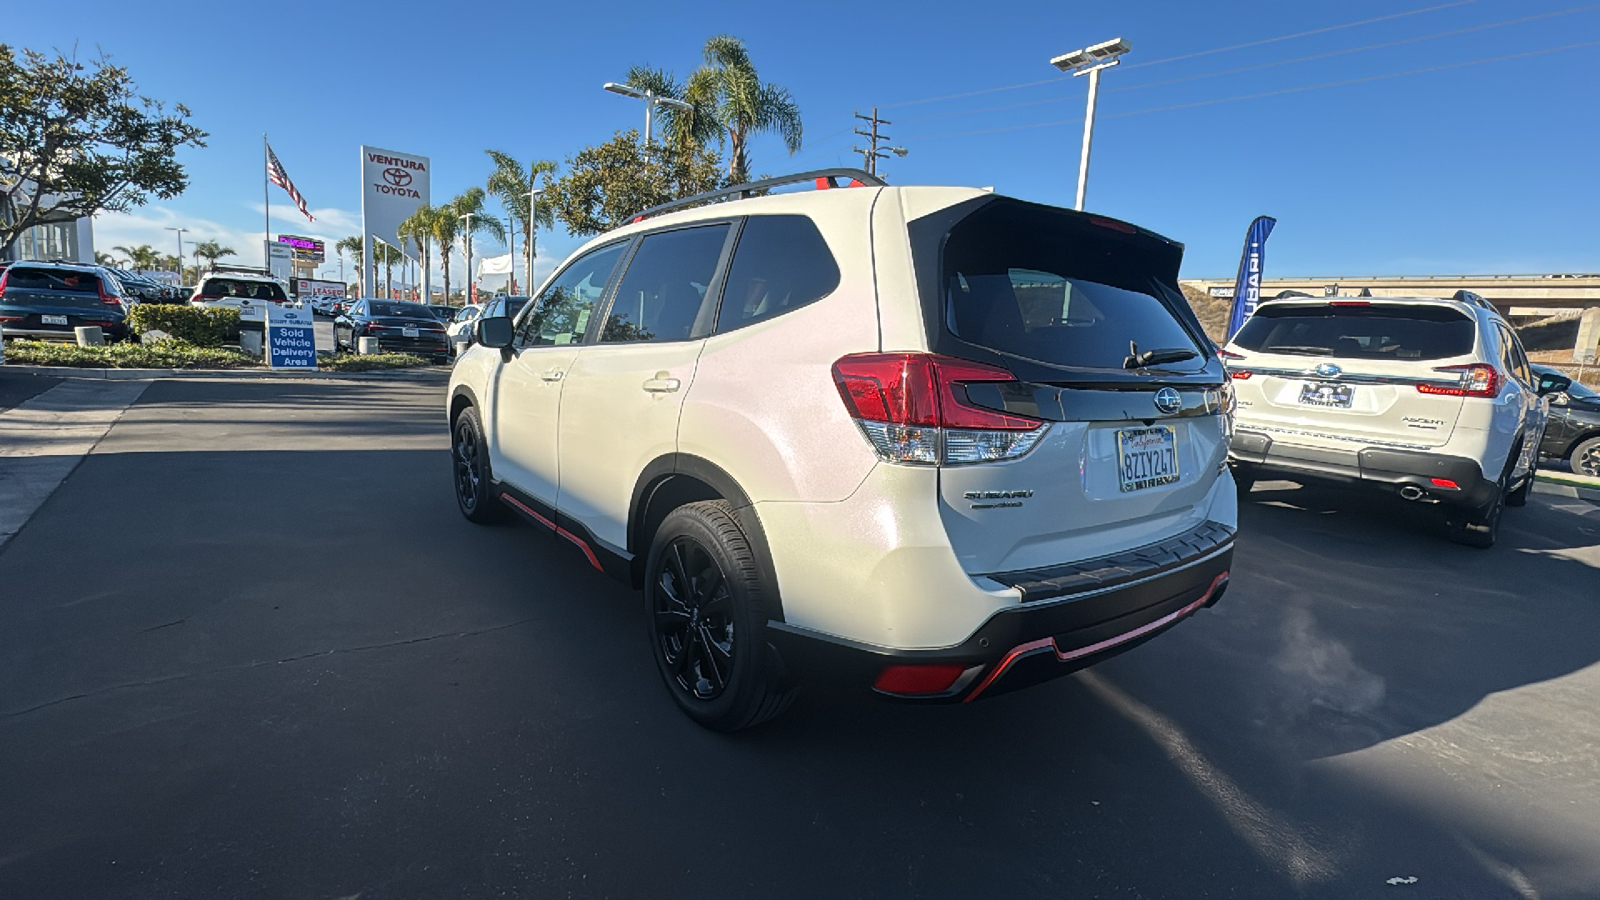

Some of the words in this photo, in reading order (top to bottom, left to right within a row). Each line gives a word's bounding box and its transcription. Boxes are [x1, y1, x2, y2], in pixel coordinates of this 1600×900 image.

[368, 153, 426, 172] VENTURA
[374, 183, 421, 199] TOYOTA
[280, 328, 304, 338] Sold
[274, 338, 311, 347] Vehicle
[272, 347, 314, 357] Delivery
[284, 358, 308, 366] Area
[1402, 416, 1445, 426] ASCENT
[1124, 447, 1173, 481] 8ZIY247
[963, 489, 1035, 500] SUBARU
